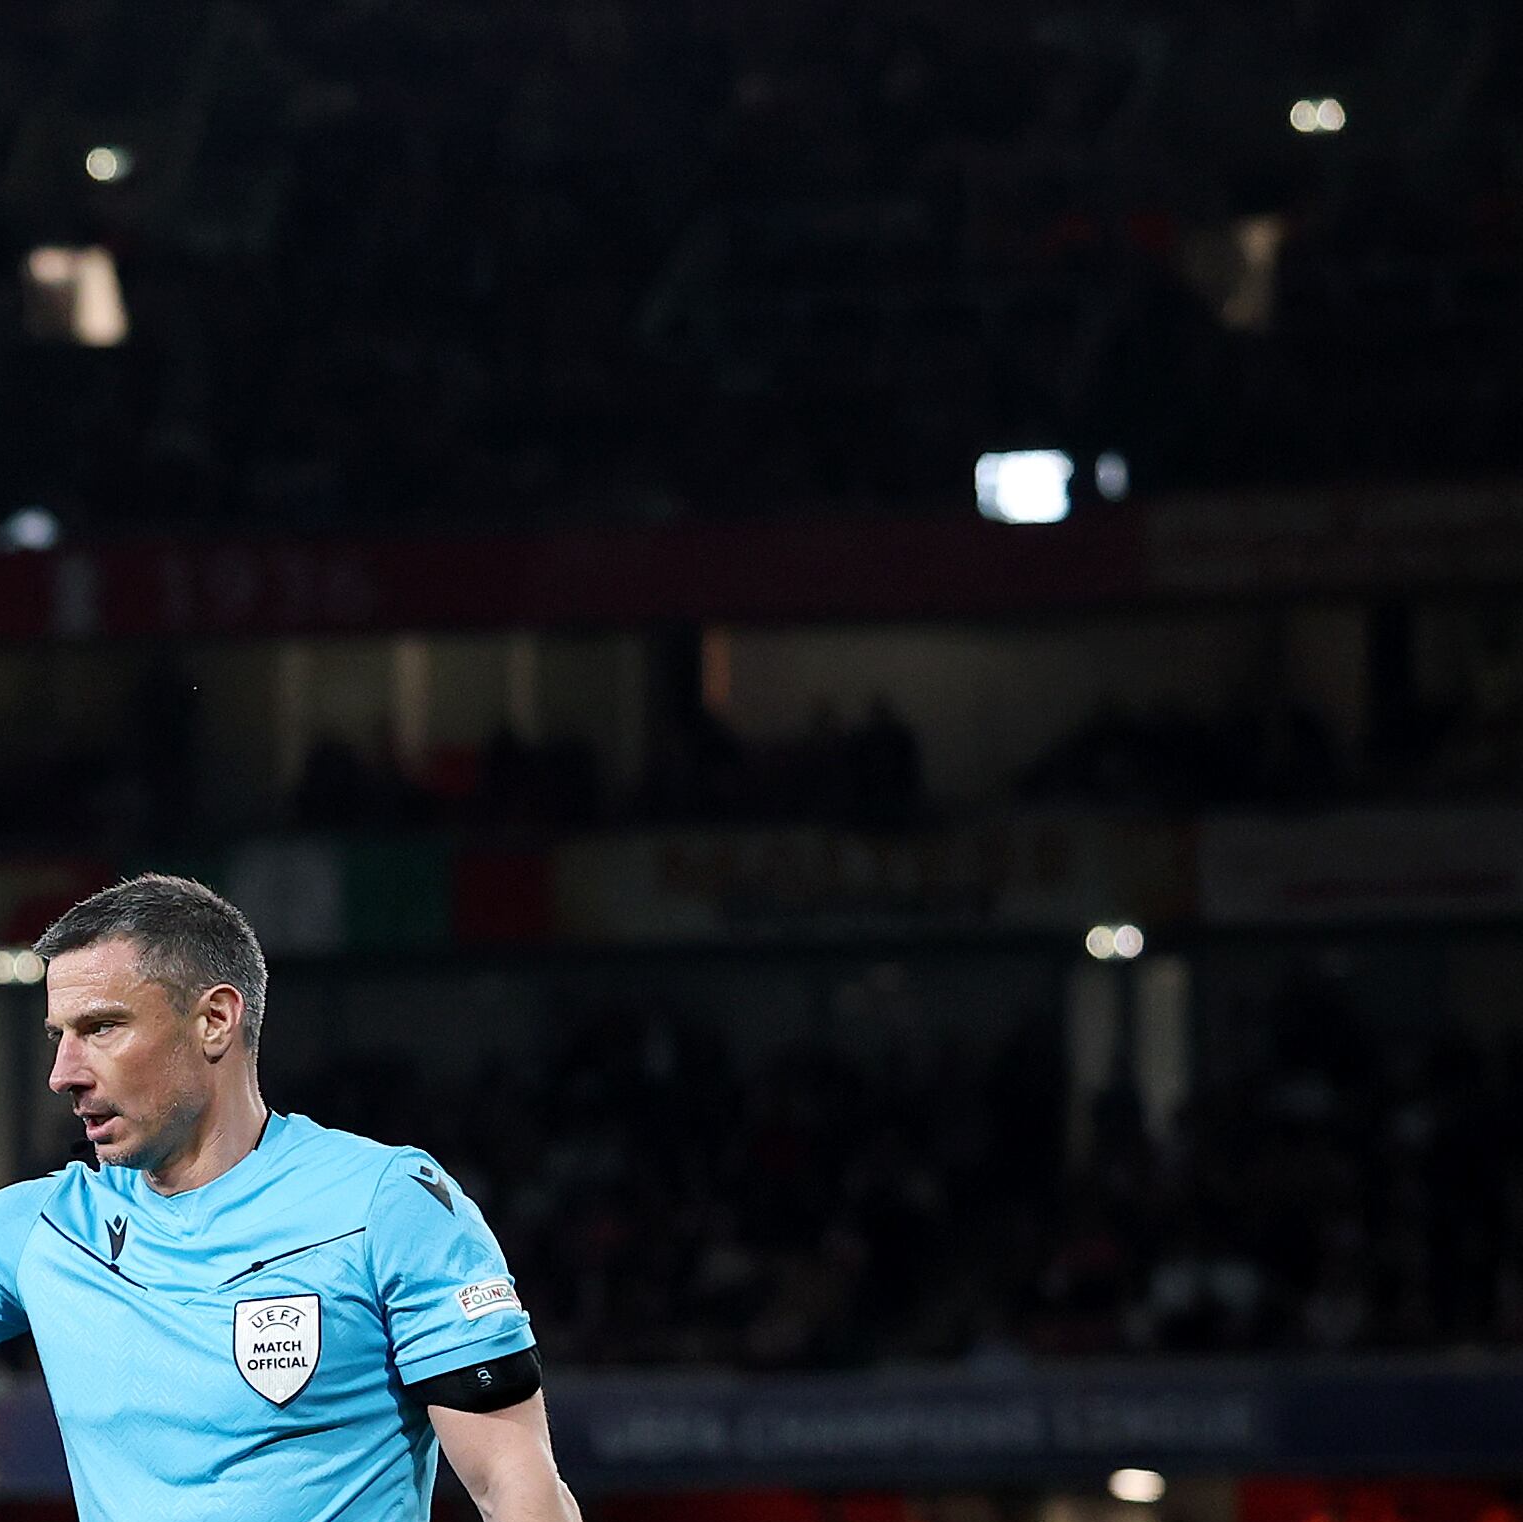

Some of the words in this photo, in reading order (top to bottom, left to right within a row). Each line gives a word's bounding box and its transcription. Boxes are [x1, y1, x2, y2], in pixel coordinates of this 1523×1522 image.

[458, 1285, 480, 1299] UEFA
[251, 1309, 300, 1329] UEFA
[253, 1340, 302, 1355] MATCH
[247, 1356, 309, 1371] OFFICIAL
